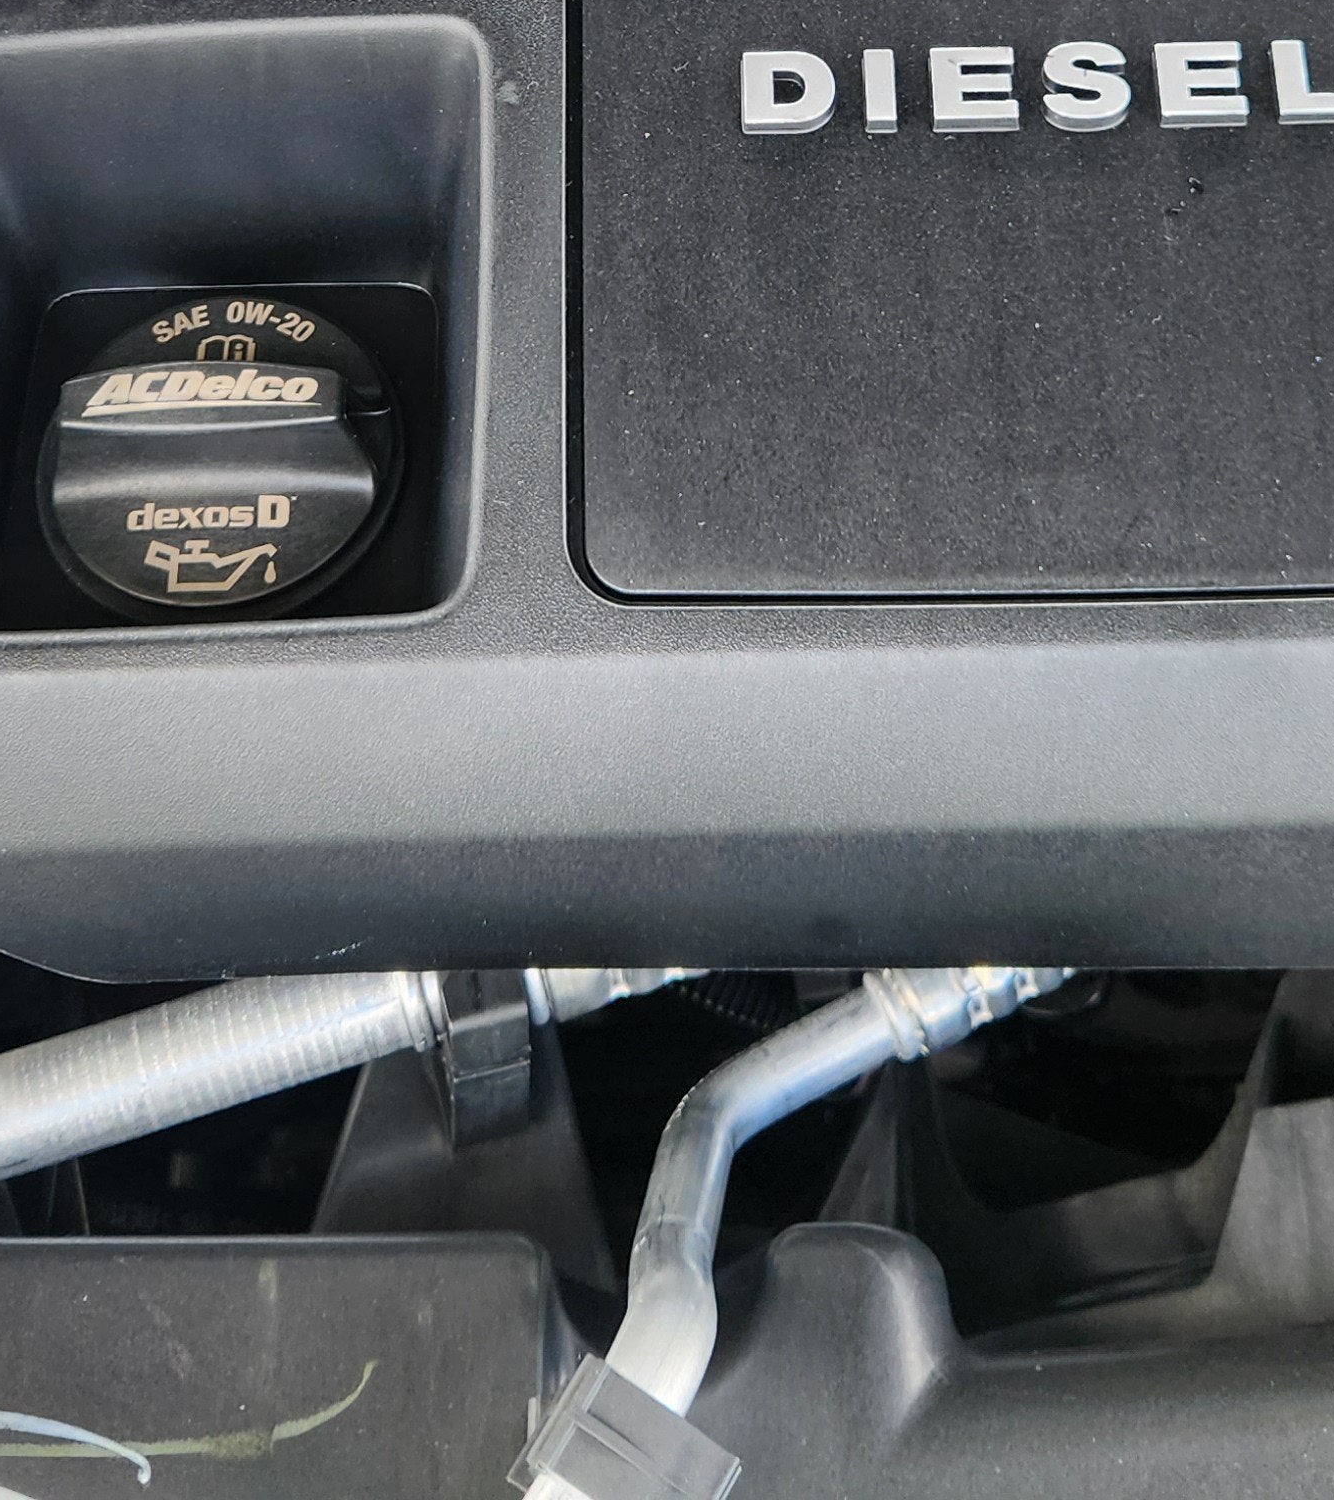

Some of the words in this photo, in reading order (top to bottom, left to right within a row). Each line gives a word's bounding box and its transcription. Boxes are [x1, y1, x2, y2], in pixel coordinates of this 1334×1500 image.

[152, 304, 211, 343] SAE
[226, 301, 316, 342] 0W-20
[85, 368, 319, 407] ACDelco
